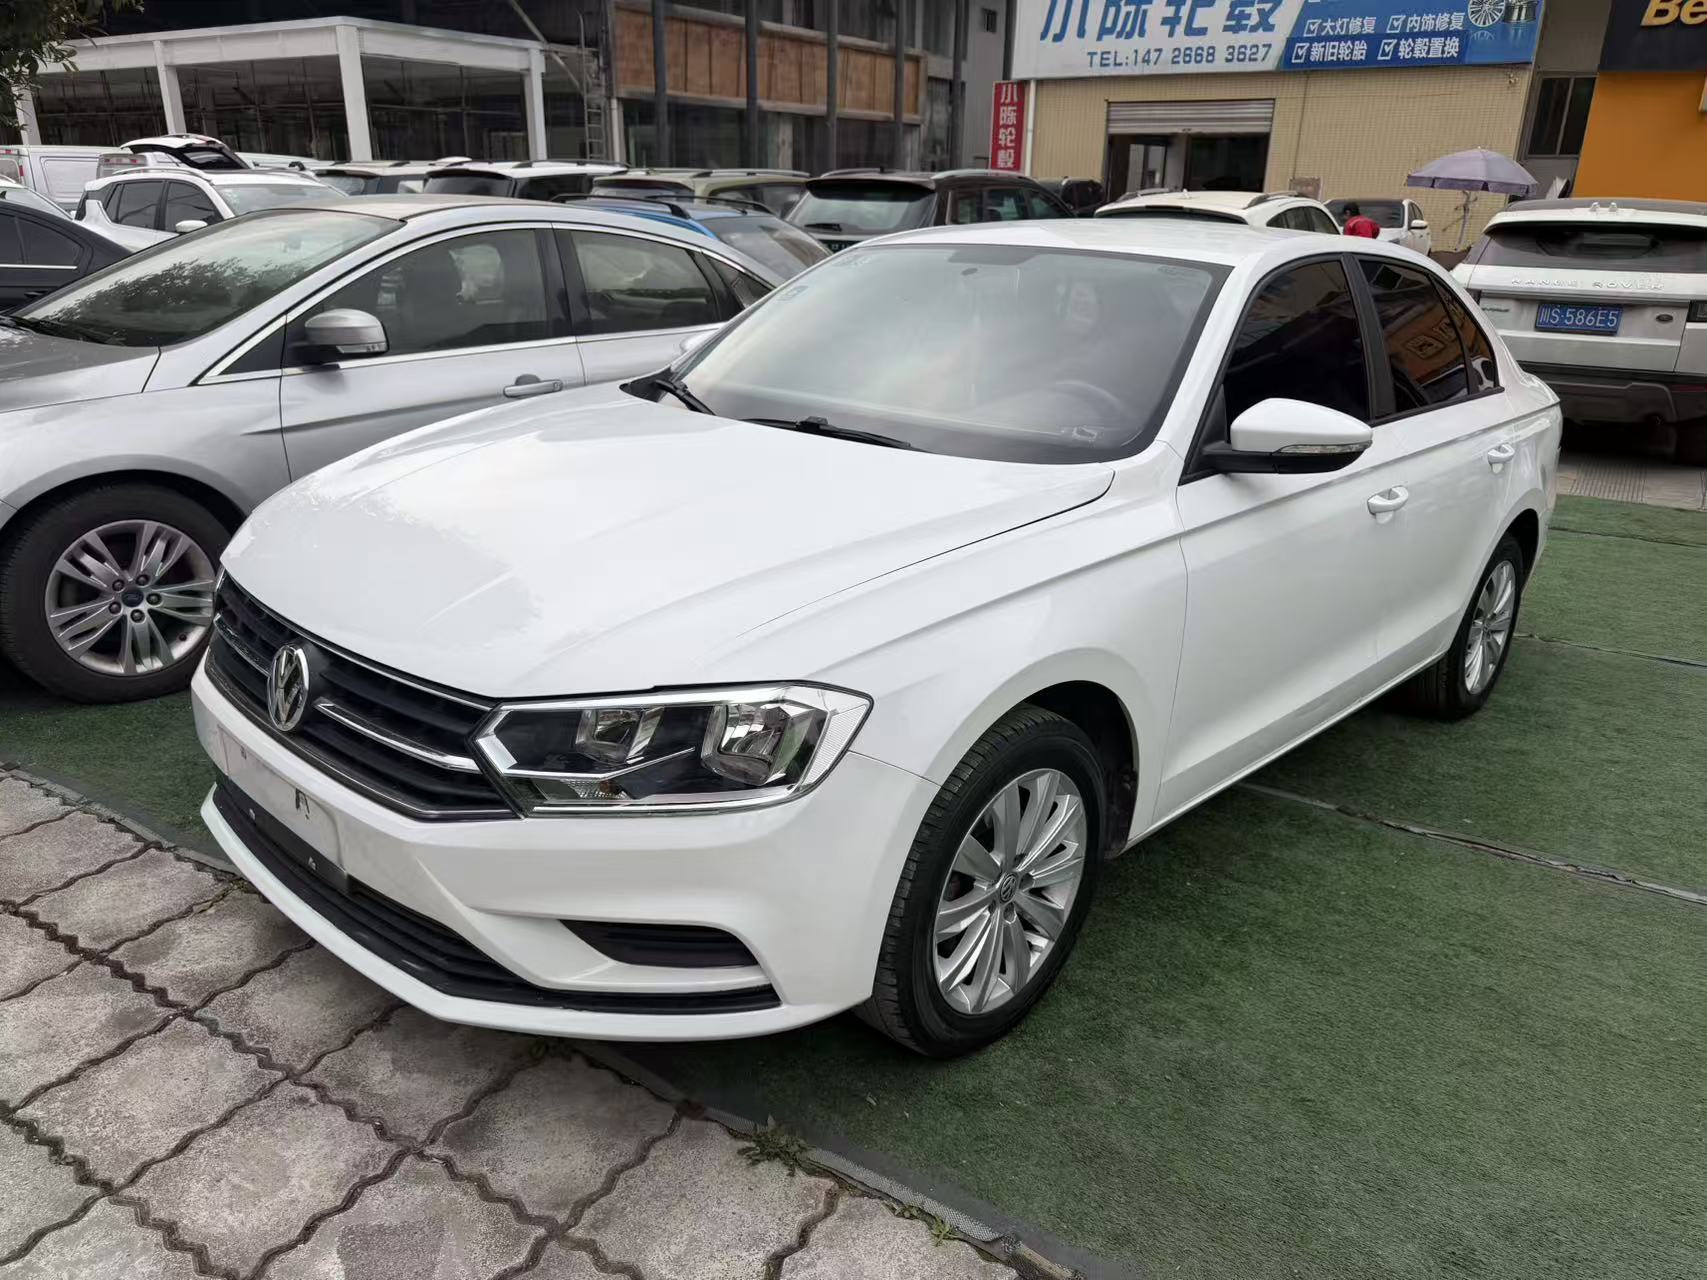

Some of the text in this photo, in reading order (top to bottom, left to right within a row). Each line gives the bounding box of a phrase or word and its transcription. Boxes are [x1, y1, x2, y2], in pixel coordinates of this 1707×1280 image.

[1321, 16, 1376, 36] 大灯修复
[1406, 12, 1465, 32] 内饰修复
[1087, 43, 1273, 68] TEL:147 2668 3627
[1310, 40, 1368, 62] 新旧轮胎
[1398, 37, 1460, 60] 轮毂置换
